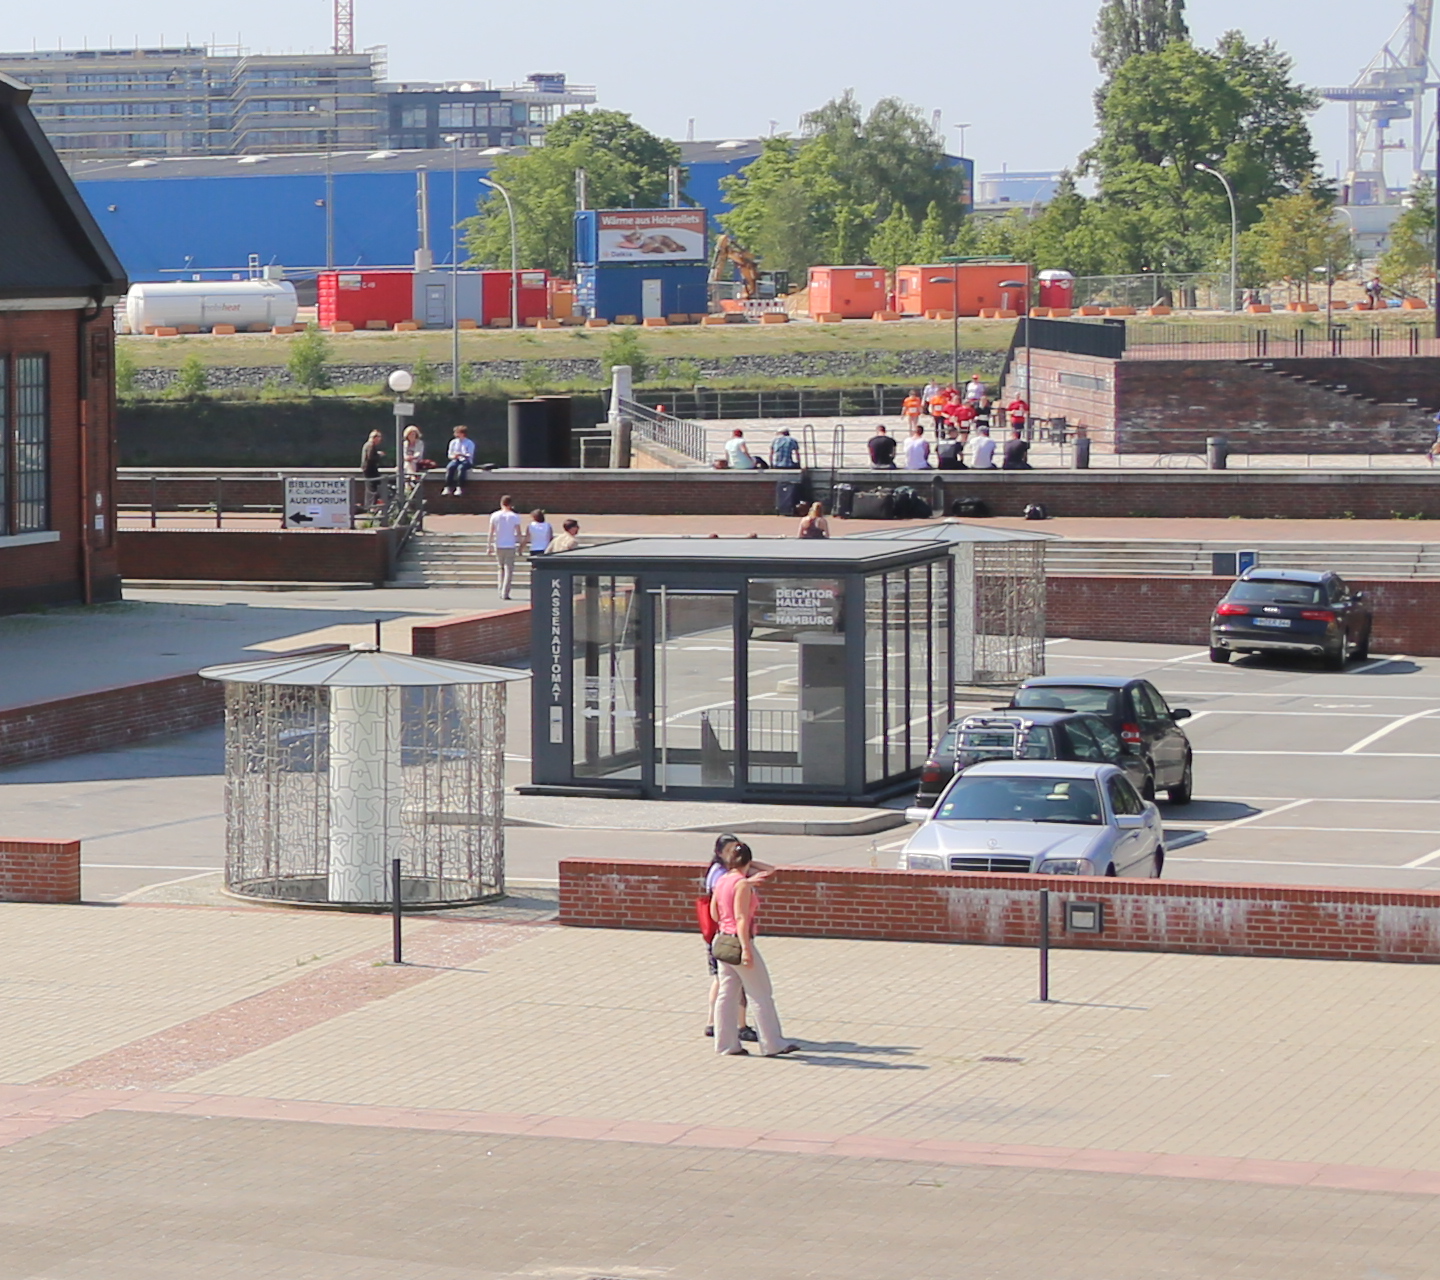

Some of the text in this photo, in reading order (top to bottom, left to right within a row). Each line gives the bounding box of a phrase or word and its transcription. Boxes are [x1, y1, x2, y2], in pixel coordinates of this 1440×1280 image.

[602, 215, 700, 226] Wärme aus Holzpellets
[775, 589, 834, 599] DEICHTOR
[775, 598, 821, 607] HALLEN
[775, 615, 834, 625] HAMBURG
[551, 579, 562, 702] KASSENAUTOMAT
